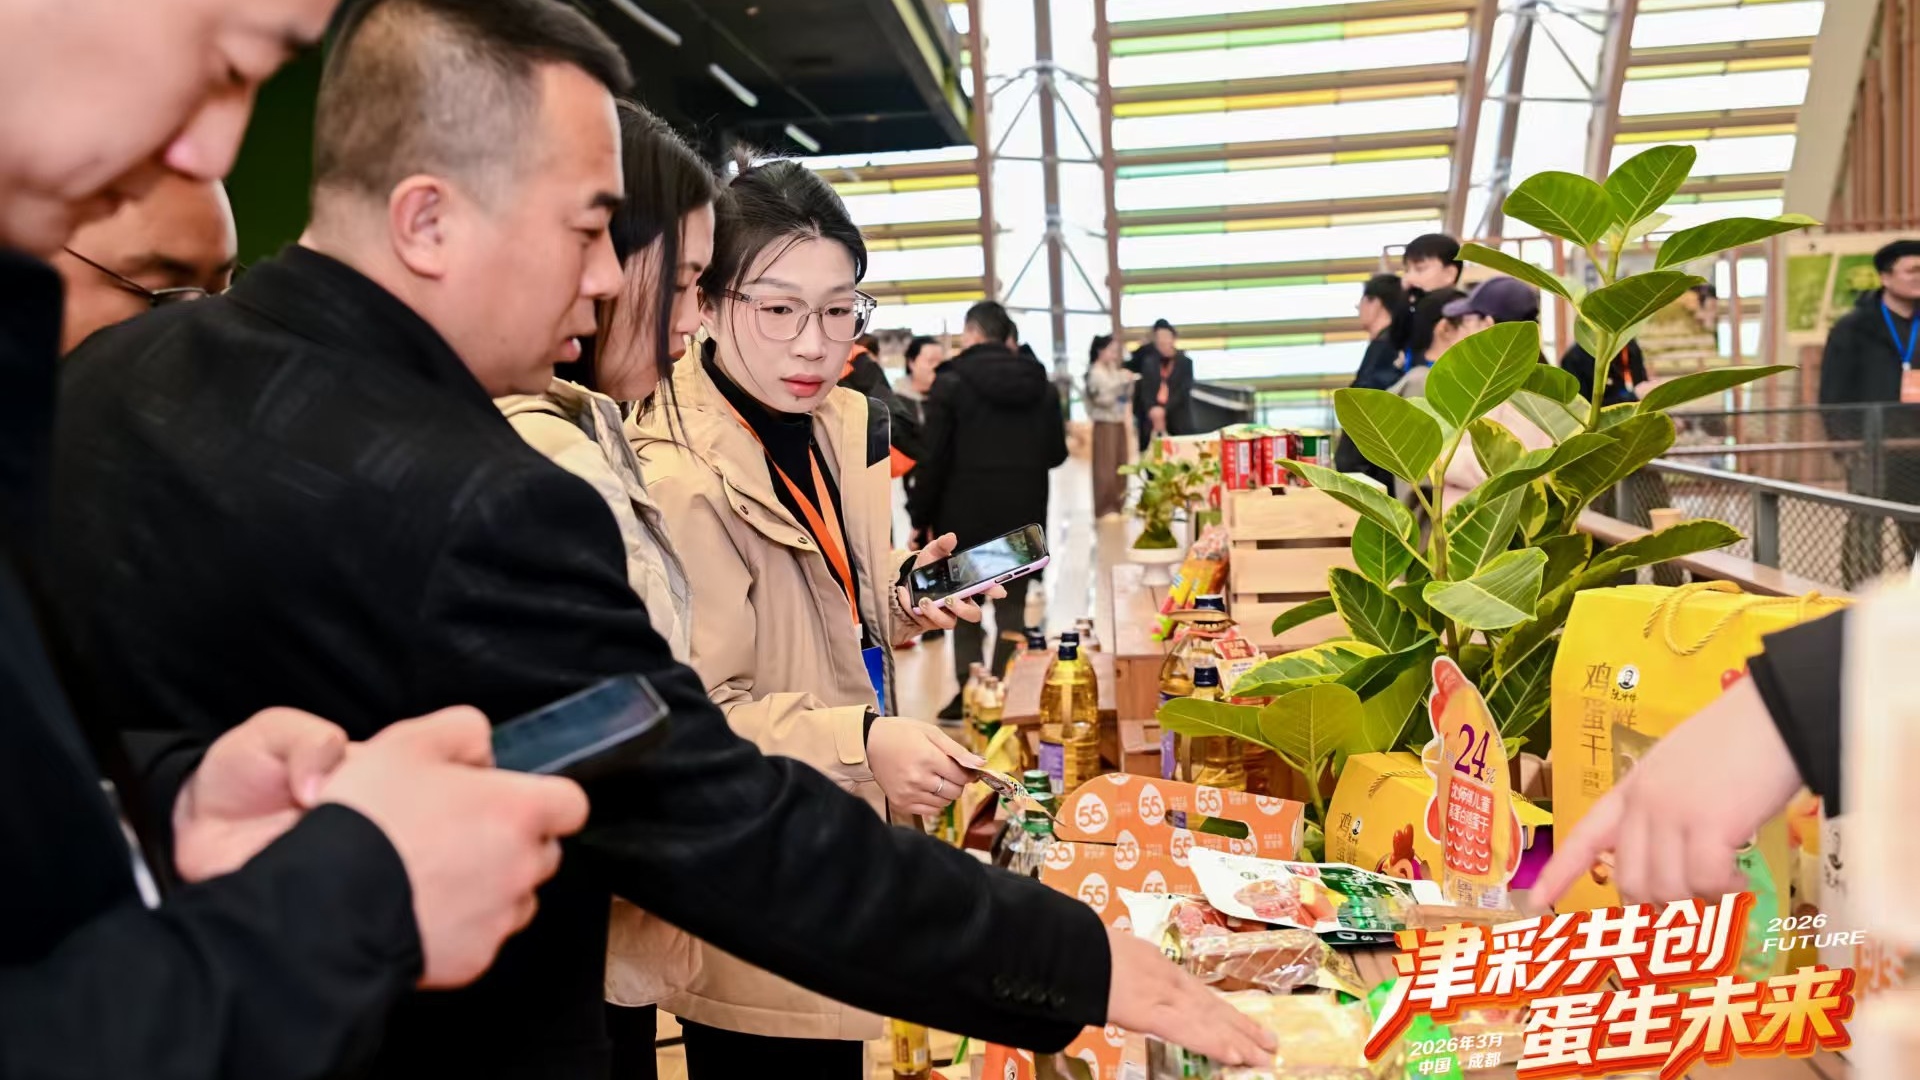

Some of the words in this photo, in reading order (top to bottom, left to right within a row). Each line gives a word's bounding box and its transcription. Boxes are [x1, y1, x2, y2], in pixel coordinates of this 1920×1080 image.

[1581, 662, 1612, 766] 鸡蛋干
[1140, 796, 1162, 819] 55
[1198, 789, 1219, 813] 55
[1077, 803, 1107, 828] 55
[1116, 842, 1137, 863] 55
[1081, 884, 1107, 907] 55
